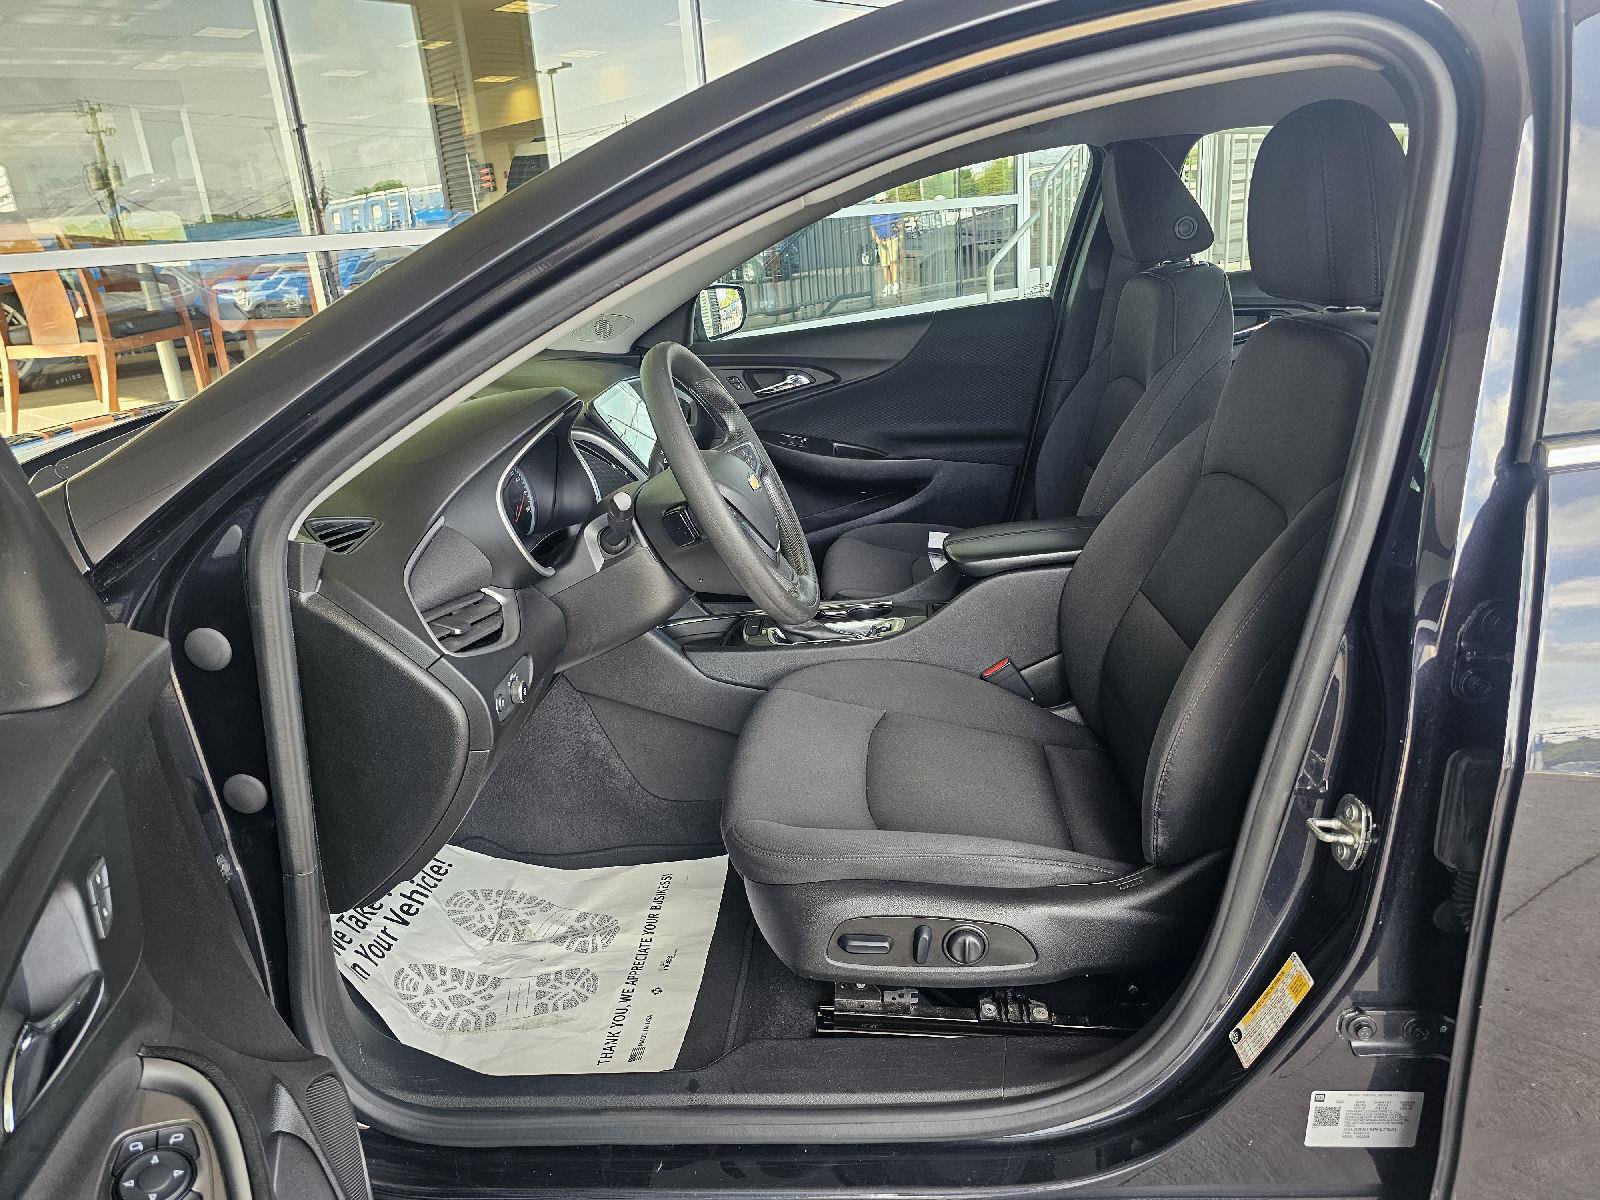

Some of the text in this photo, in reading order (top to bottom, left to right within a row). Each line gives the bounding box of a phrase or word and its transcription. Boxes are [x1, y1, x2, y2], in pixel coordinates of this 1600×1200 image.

[354, 925, 399, 967] Your
[383, 857, 453, 927] Vehicle!
[642, 913, 661, 936] YOUR
[625, 937, 653, 987] APPRECIATE
[618, 988, 635, 1004] WE
[609, 1004, 632, 1029] YOU,
[596, 1030, 622, 1066] THANK
